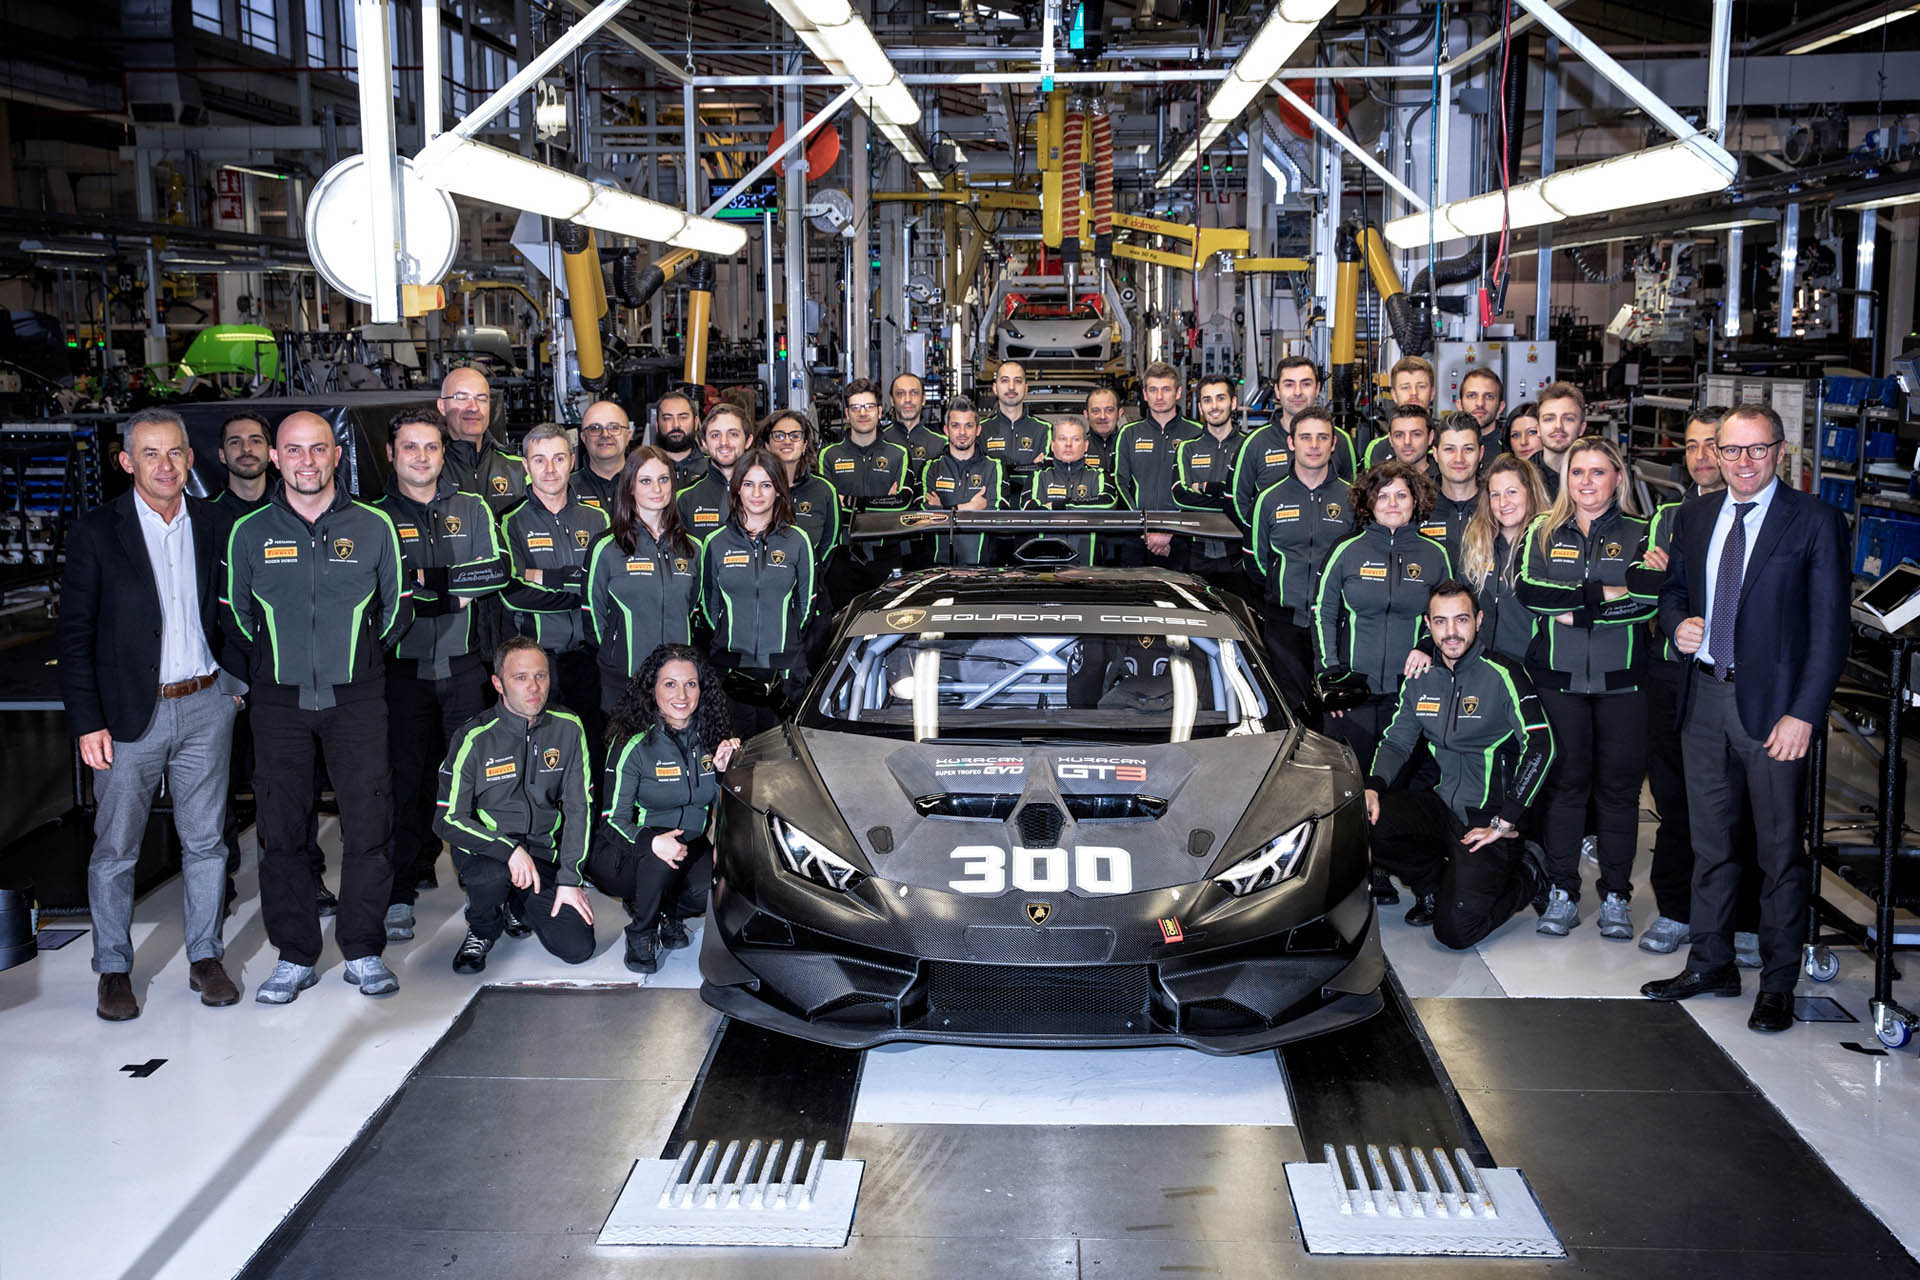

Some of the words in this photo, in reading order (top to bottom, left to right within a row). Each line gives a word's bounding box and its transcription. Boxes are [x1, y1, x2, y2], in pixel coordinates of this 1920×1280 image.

[1100, 615, 1207, 626] CORSE
[1058, 757, 1147, 765] HURACAN
[935, 769, 956, 777] SUPER
[982, 766, 1025, 775] EVO
[1058, 764, 1147, 781] GT3
[948, 845, 1133, 894] 300
